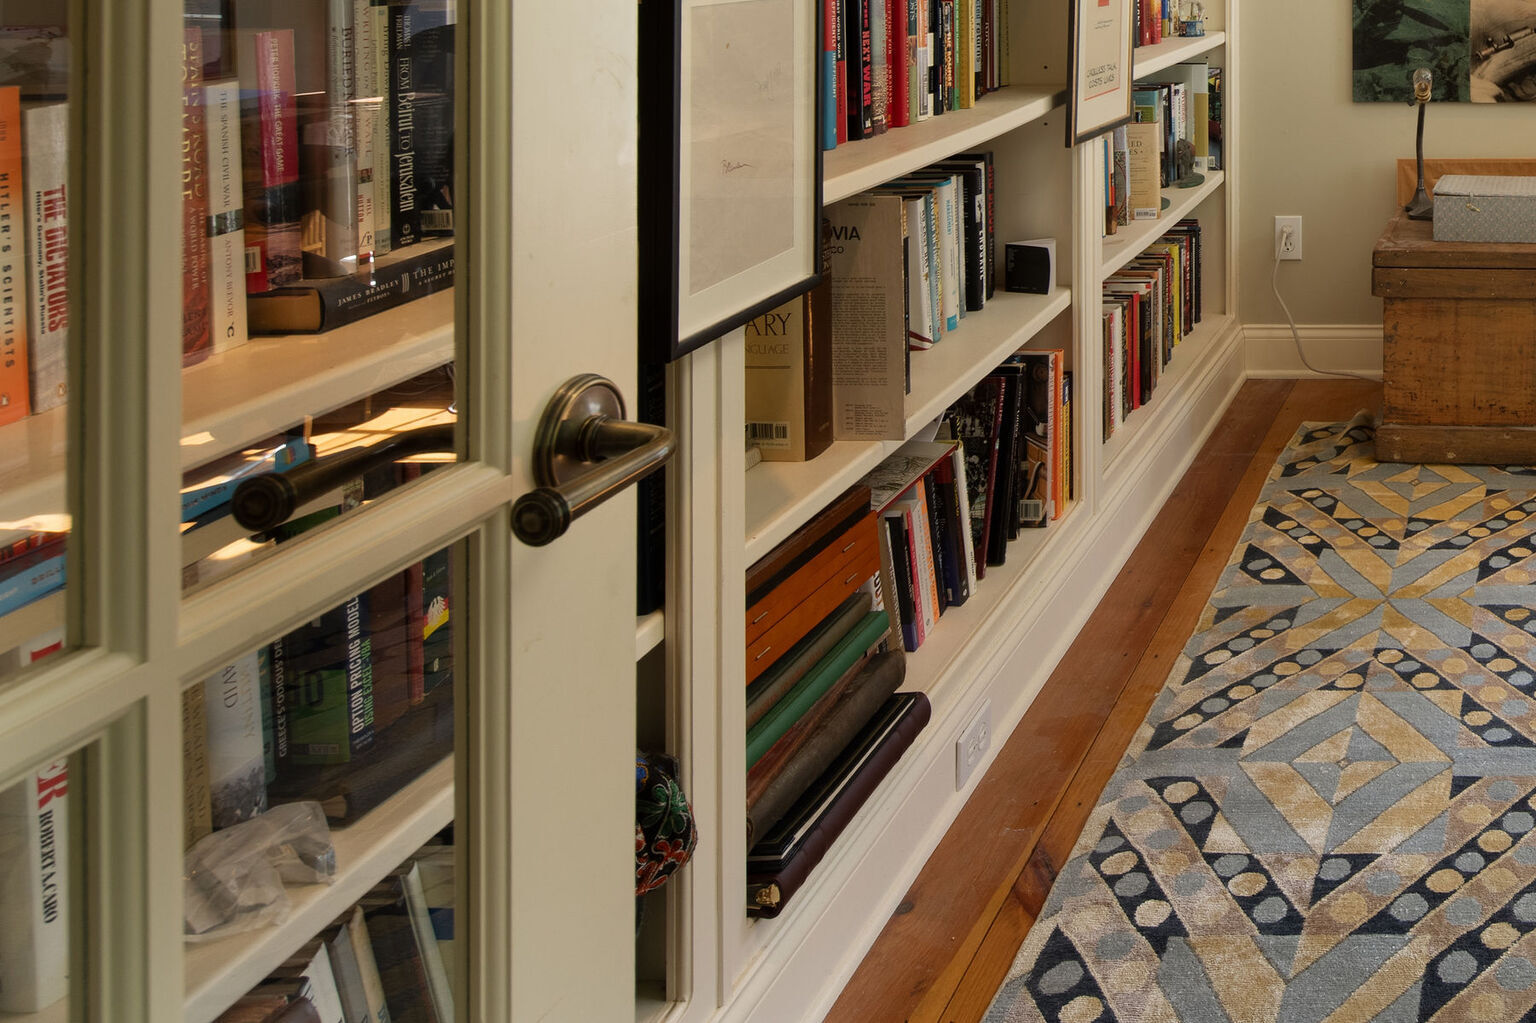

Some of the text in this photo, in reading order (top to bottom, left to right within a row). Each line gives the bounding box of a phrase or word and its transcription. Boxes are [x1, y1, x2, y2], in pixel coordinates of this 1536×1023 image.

[270, 38, 279, 61] PETER
[342, 27, 353, 89] BURIED
[861, 30, 871, 63] NEXT
[861, 64, 872, 107] WAR
[273, 104, 282, 119] THE
[219, 91, 232, 208] THE SPANISH CIVIL WAR
[274, 121, 283, 145] GREAT
[393, 57, 417, 213] FROM Beirut TO Jerusalem
[192, 134, 205, 198] ROAD
[275, 148, 285, 174] GAME
[35, 190, 43, 224] Hitler's
[0, 172, 16, 369] HITLER'S SCIENTISTS
[43, 184, 68, 333] THE DICTATORS
[412, 266, 434, 280] THE
[38, 269, 46, 303] Stalin's
[337, 279, 400, 307] JAMES BRADLEY
[349, 638, 365, 734] OPTION PRICING
[362, 663, 374, 696] EXCEL
[362, 695, 375, 726] USING
[276, 706, 288, 757] GREECE'S
[40, 809, 59, 925] ROBERT CARO
